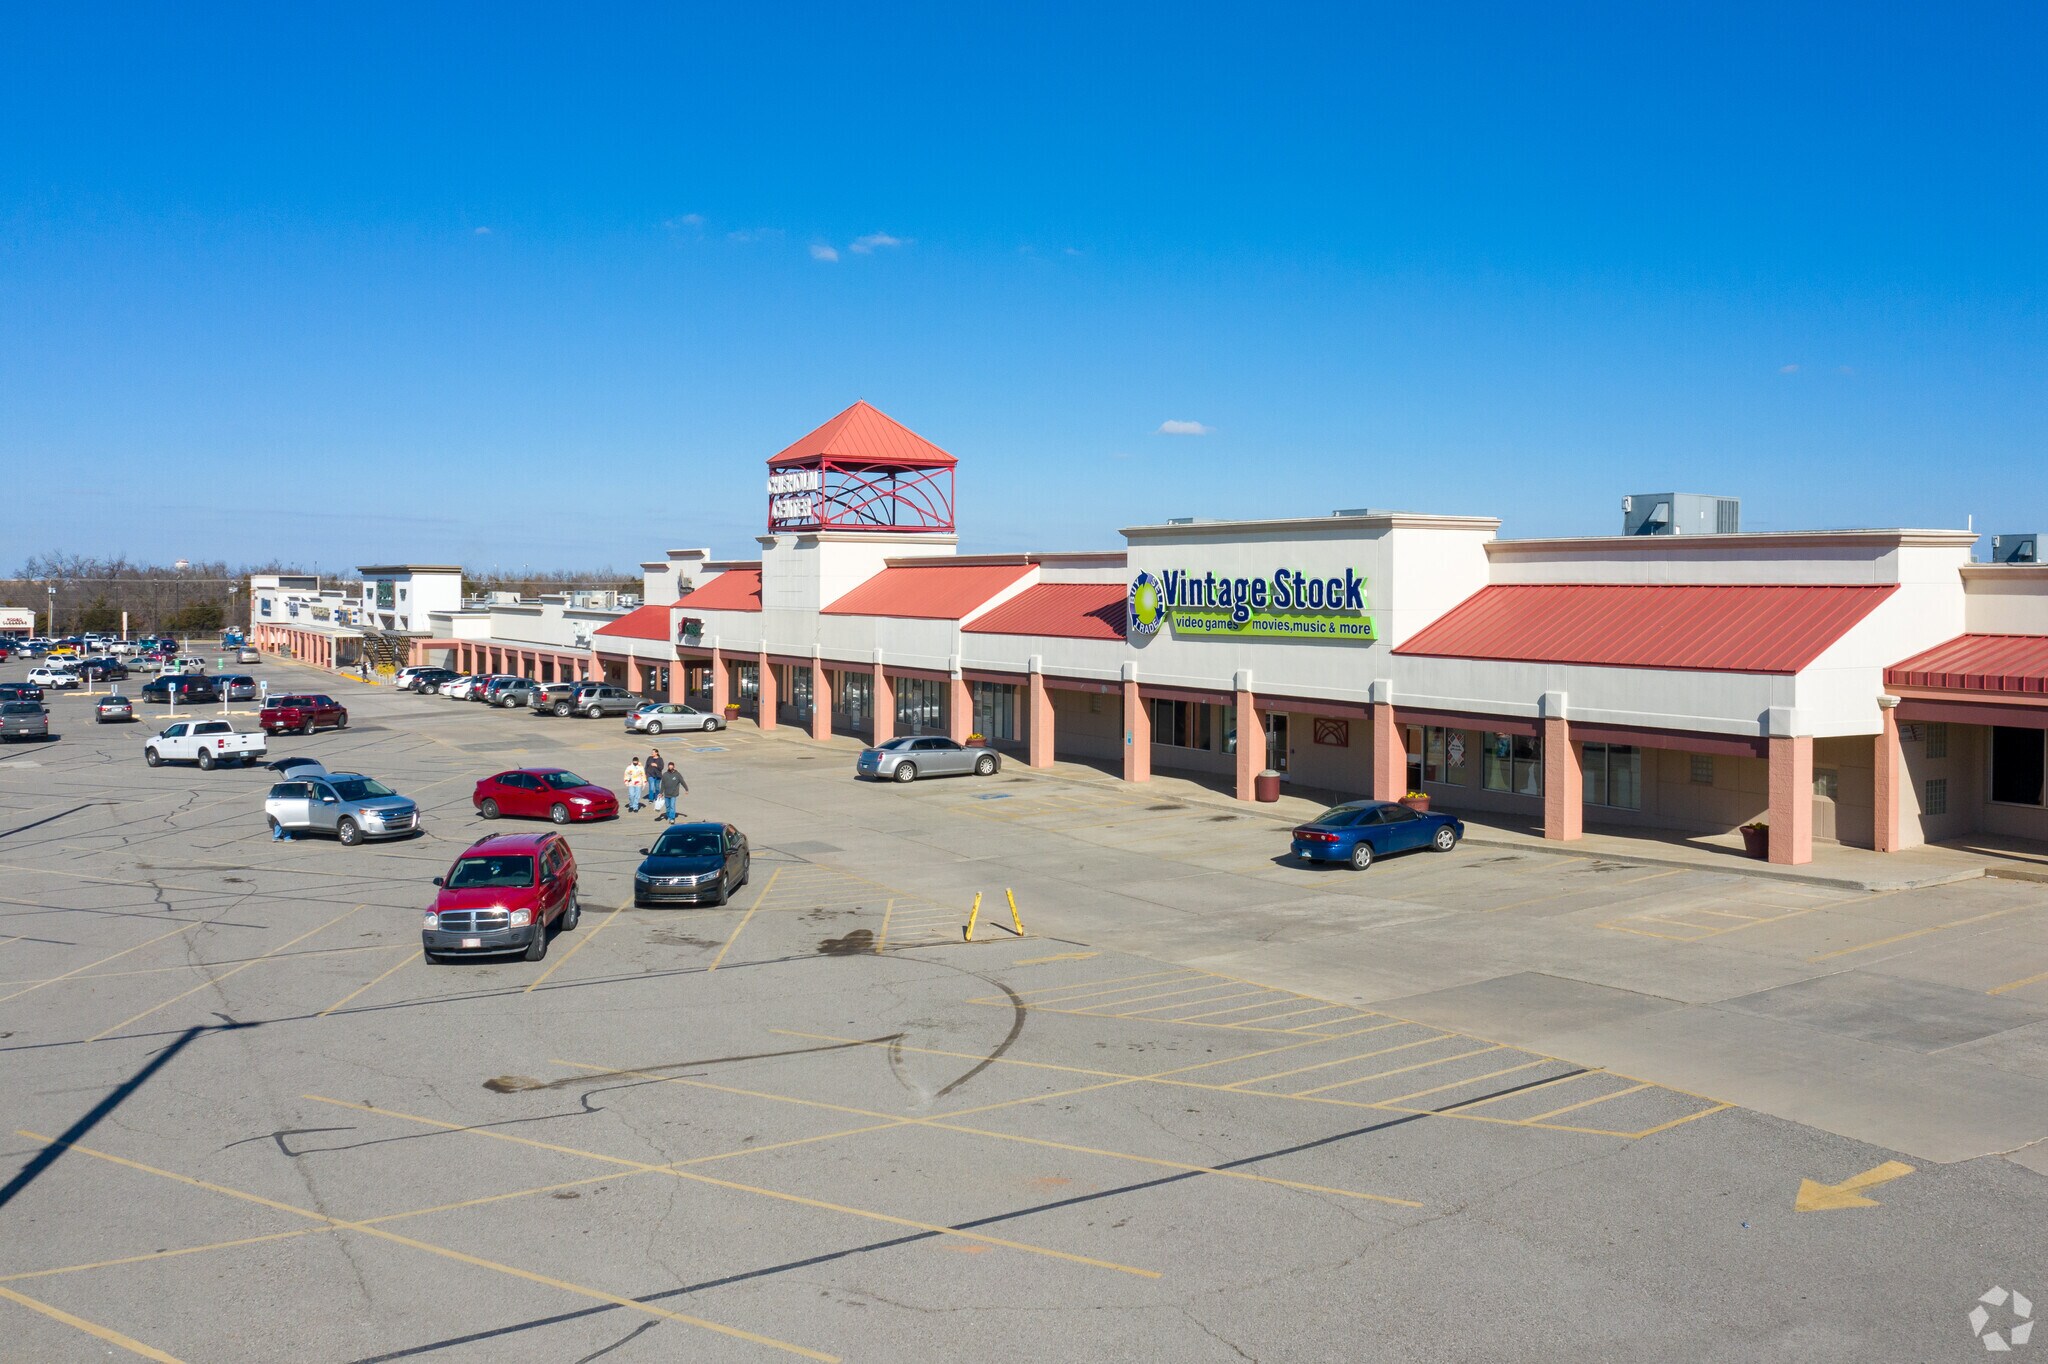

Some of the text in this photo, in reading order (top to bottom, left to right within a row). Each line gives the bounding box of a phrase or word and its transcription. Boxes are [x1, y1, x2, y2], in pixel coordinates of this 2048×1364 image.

[772, 497, 812, 519] CENTER
[1130, 578, 1140, 605] BUY
[1150, 577, 1163, 609] SELL
[1162, 567, 1365, 623] Vintage Stock
[1134, 617, 1159, 634] TRADE
[1175, 616, 1204, 628] video
[1205, 619, 1239, 632] games
[1328, 622, 1336, 633] &
[1339, 623, 1371, 635] more
